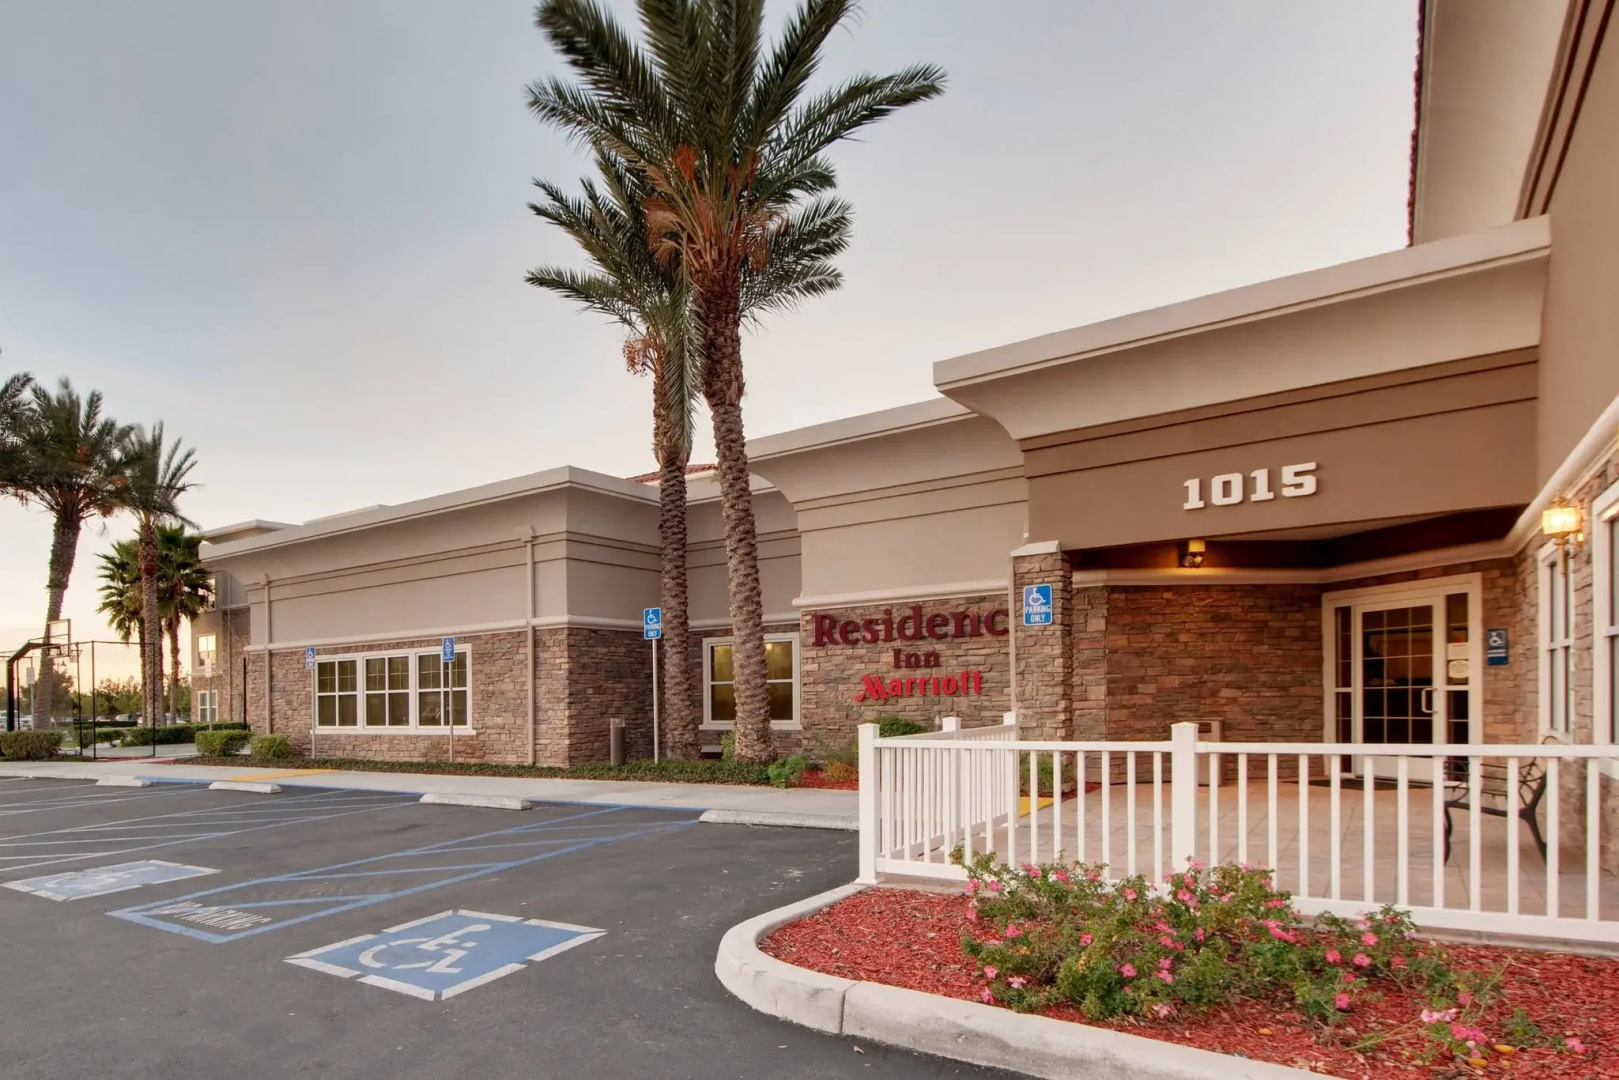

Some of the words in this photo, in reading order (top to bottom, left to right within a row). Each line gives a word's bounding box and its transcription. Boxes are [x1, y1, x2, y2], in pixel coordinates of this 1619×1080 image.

[1183, 461, 1317, 510] 1015
[1025, 605, 1051, 614] PARKING
[1030, 614, 1045, 623] ONLY
[812, 604, 1009, 647] Residenc
[892, 648, 941, 669] Inn
[855, 670, 982, 703] Marriott
